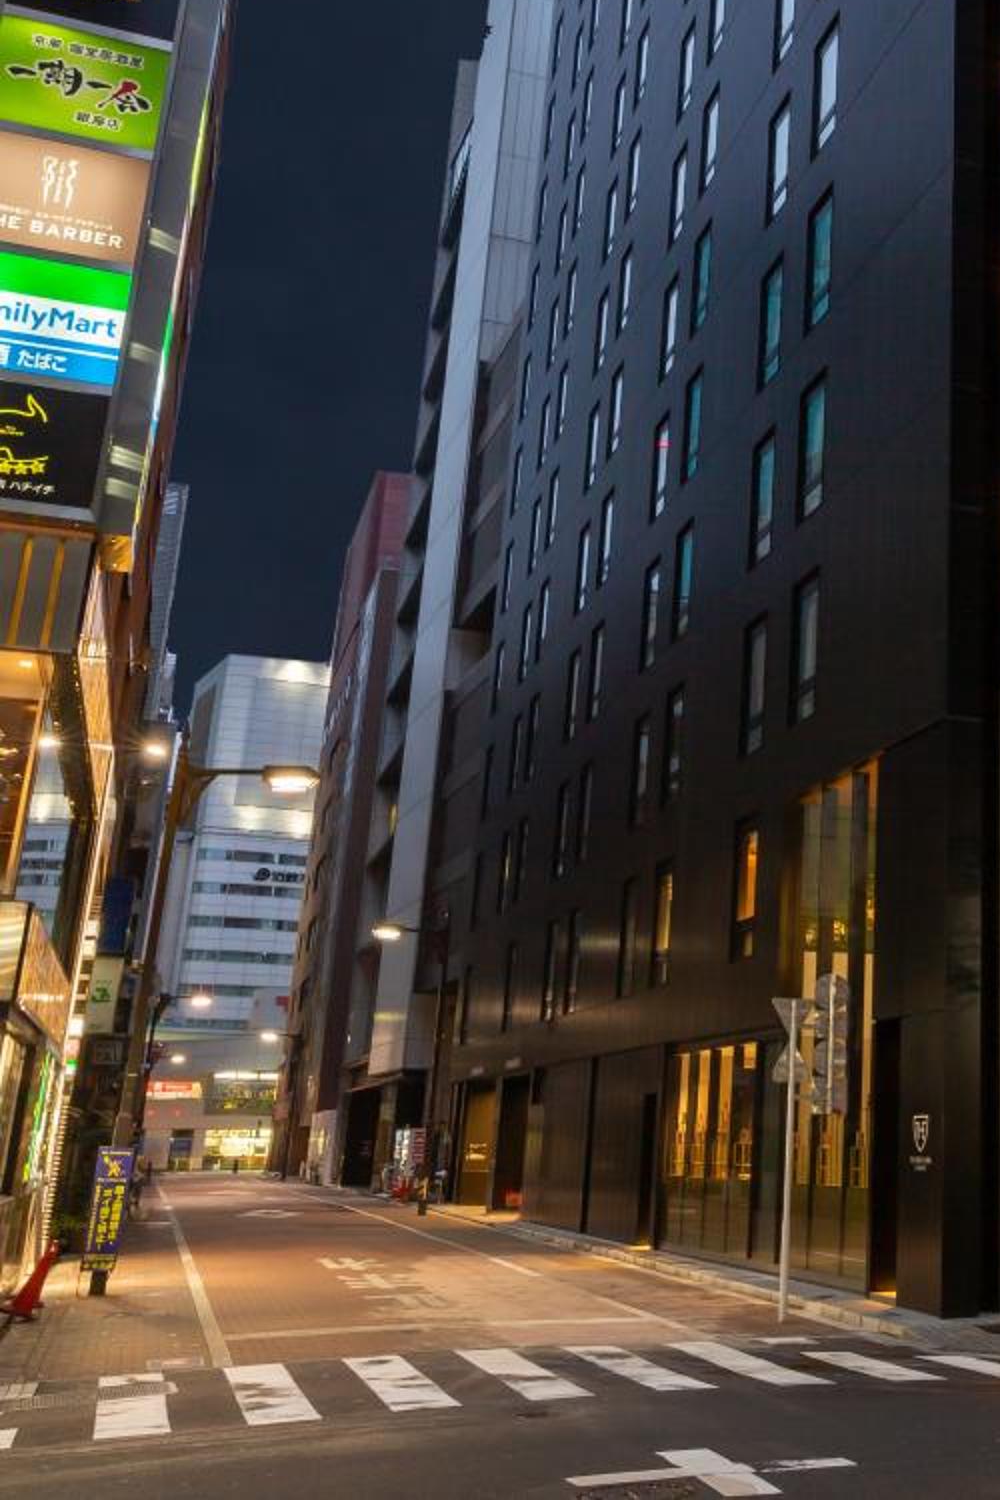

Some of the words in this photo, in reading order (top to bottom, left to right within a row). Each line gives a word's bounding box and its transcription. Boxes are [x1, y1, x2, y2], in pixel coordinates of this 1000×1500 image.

[30, 220, 123, 249] BARBER
[17, 349, 67, 373] たばこ
